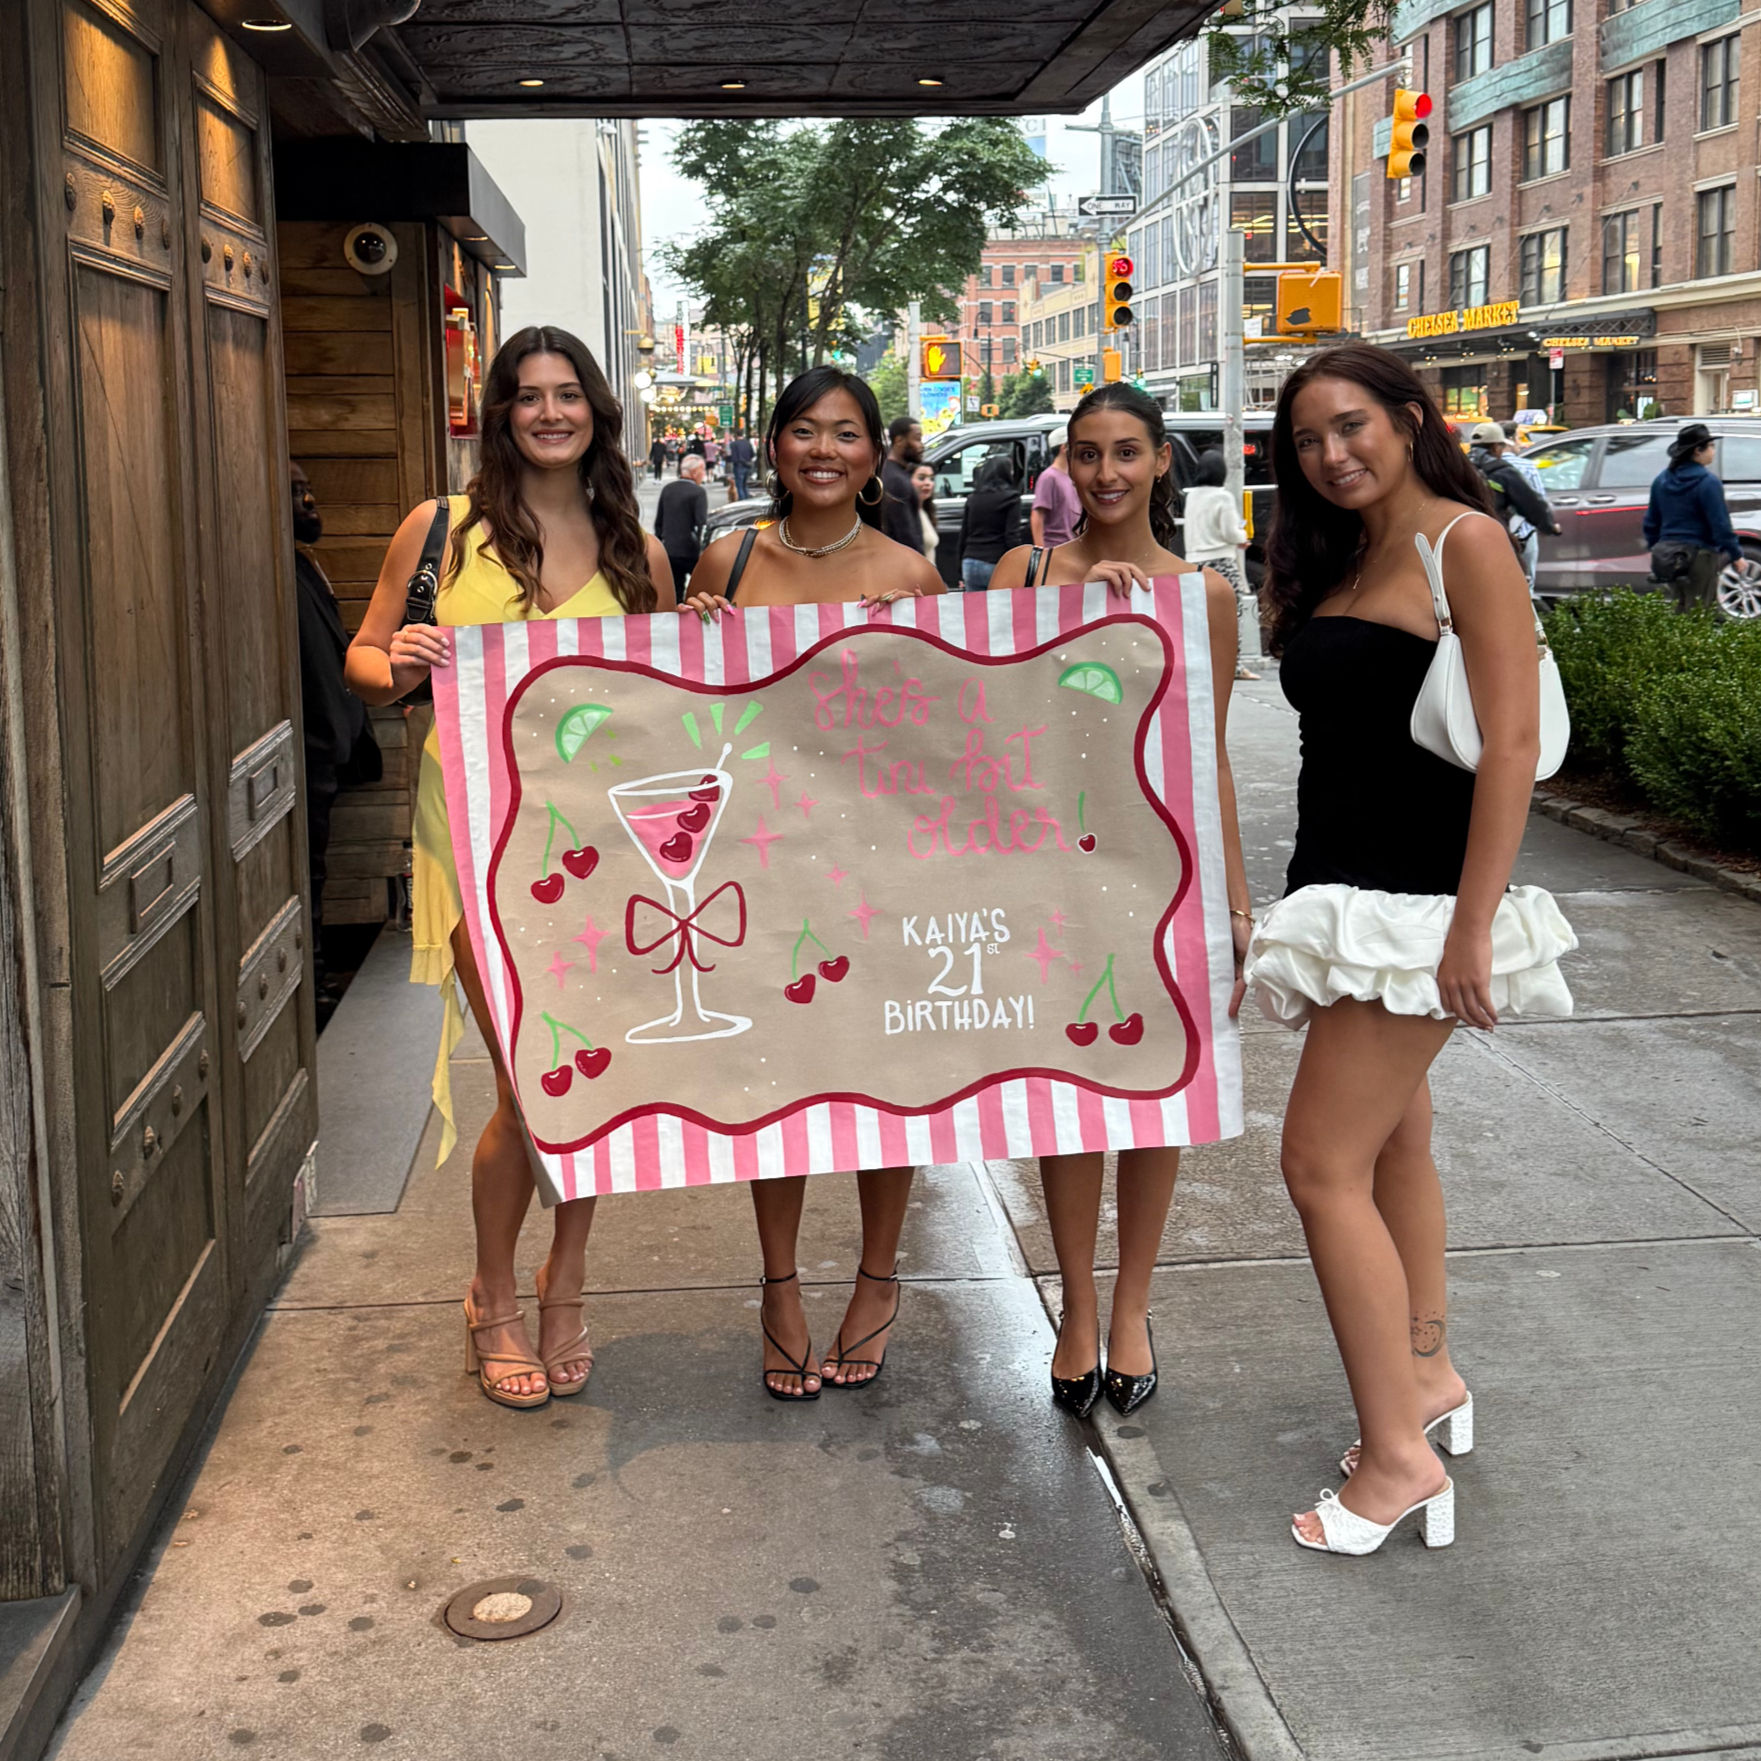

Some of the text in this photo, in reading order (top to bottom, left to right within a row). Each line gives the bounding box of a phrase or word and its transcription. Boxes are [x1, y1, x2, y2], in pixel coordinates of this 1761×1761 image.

[1114, 201, 1132, 209] WAY
[1407, 300, 1520, 340] CHELSEA MARKET
[957, 677, 996, 724] a
[949, 724, 1049, 792] bit
[902, 907, 1011, 946] KAIYA'S
